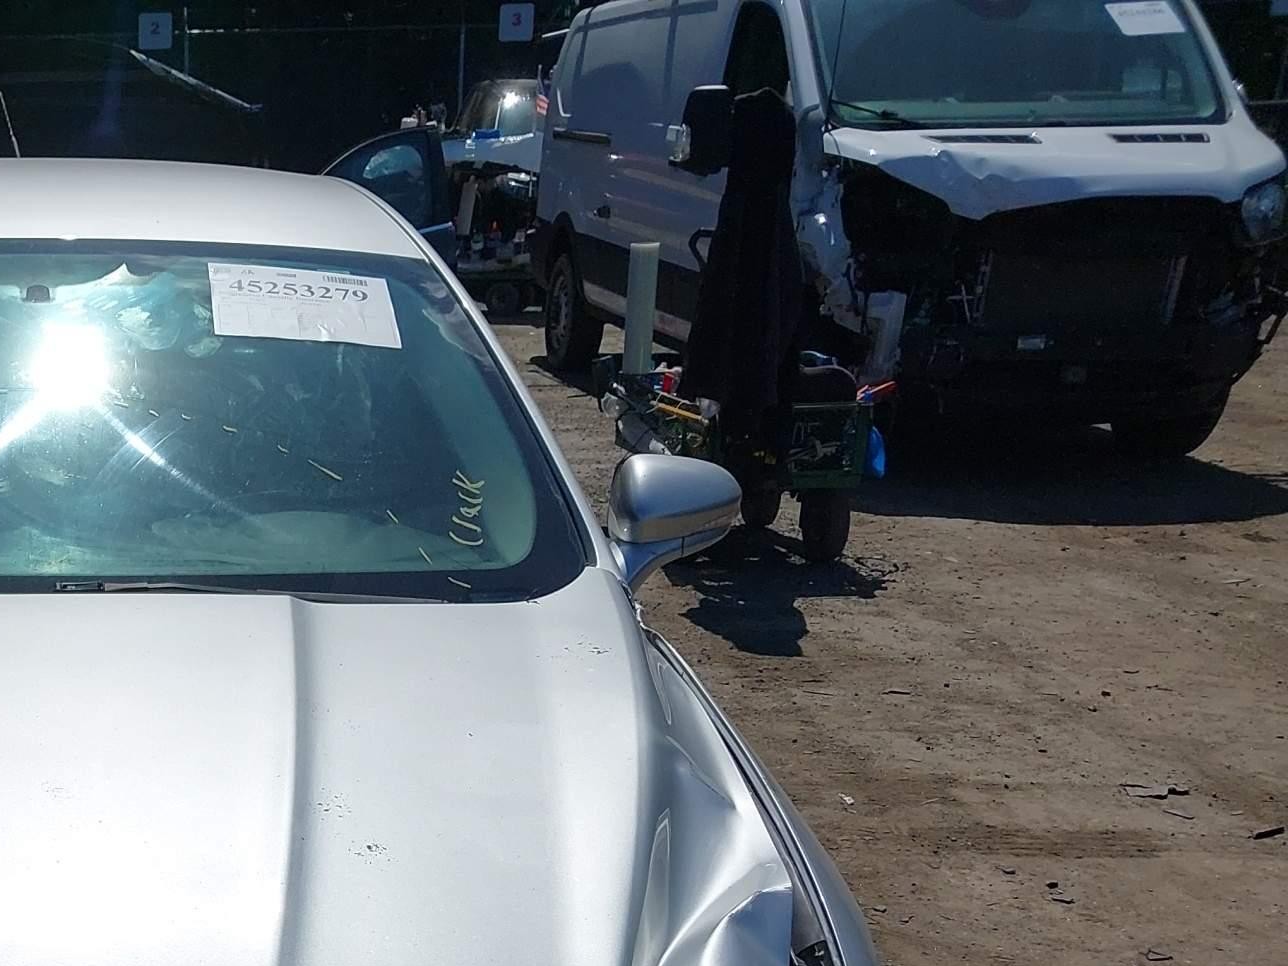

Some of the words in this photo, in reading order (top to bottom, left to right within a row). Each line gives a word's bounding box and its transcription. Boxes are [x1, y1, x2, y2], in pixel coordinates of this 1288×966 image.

[511, 13, 522, 27] 3
[150, 21, 161, 36] 2
[228, 278, 370, 303] 45253279
